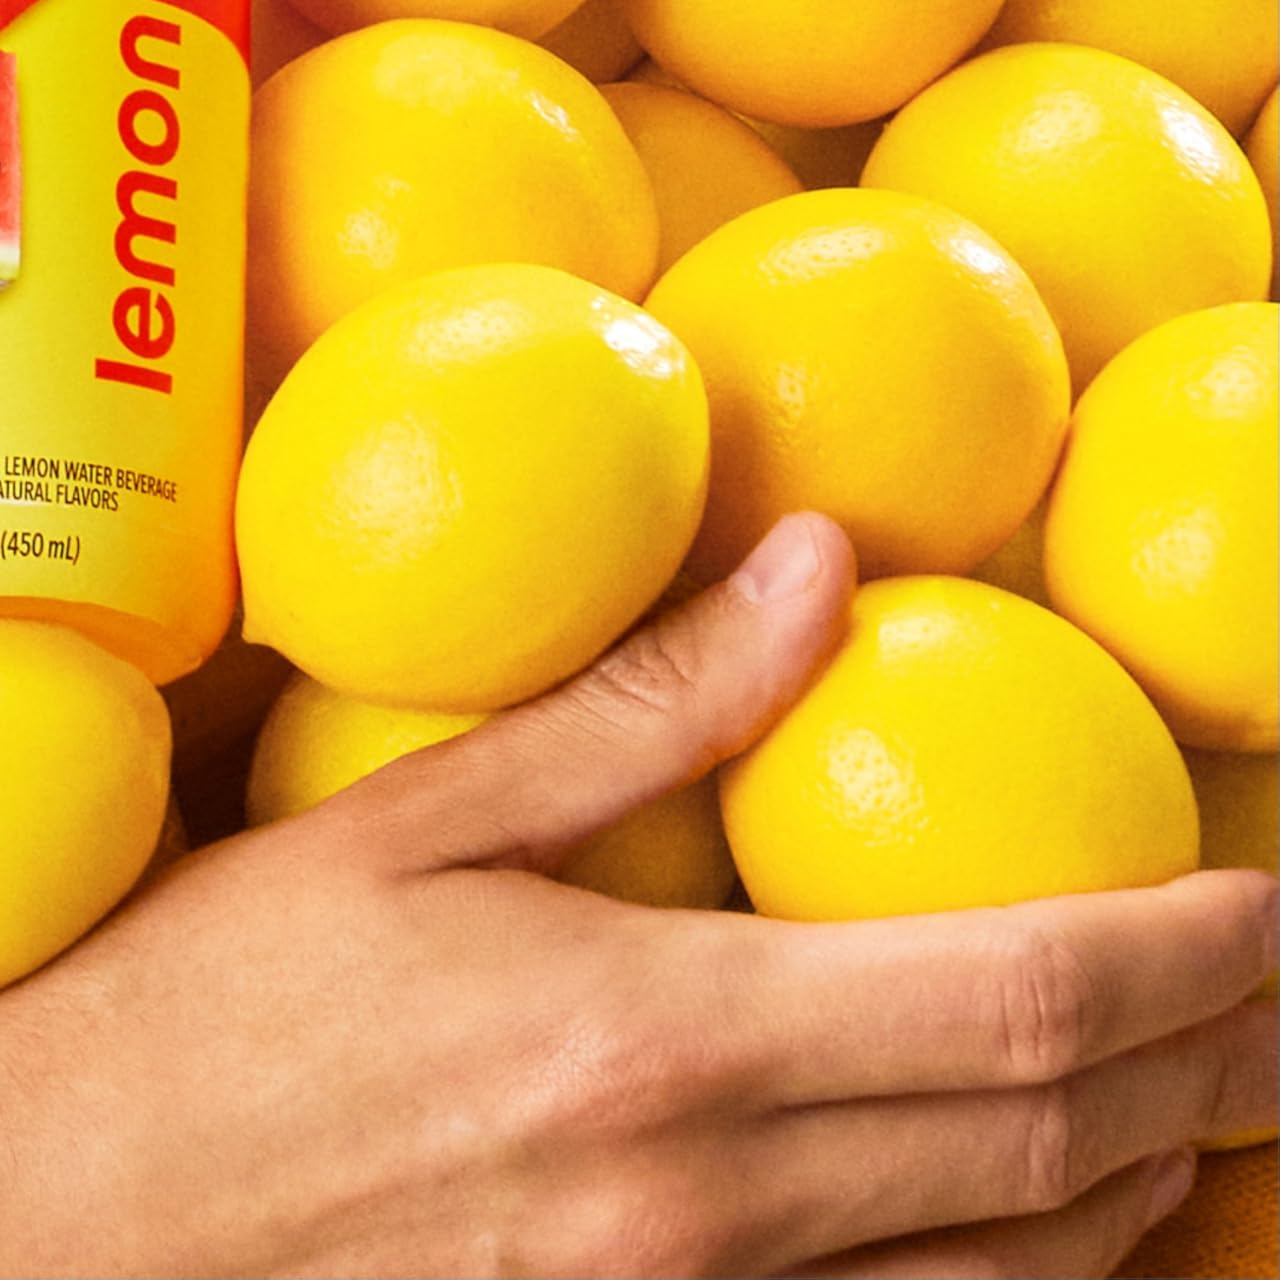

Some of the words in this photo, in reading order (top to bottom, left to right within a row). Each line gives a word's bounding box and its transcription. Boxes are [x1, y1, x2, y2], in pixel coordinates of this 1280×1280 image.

[94, 14, 182, 395] lemon
[4, 456, 60, 480] LEMON
[64, 461, 113, 487] WATER
[116, 469, 177, 503] BEVERAGE
[55, 486, 119, 512] FLAVORS
[0, 531, 44, 561] (450
[47, 535, 81, 566] mL)
